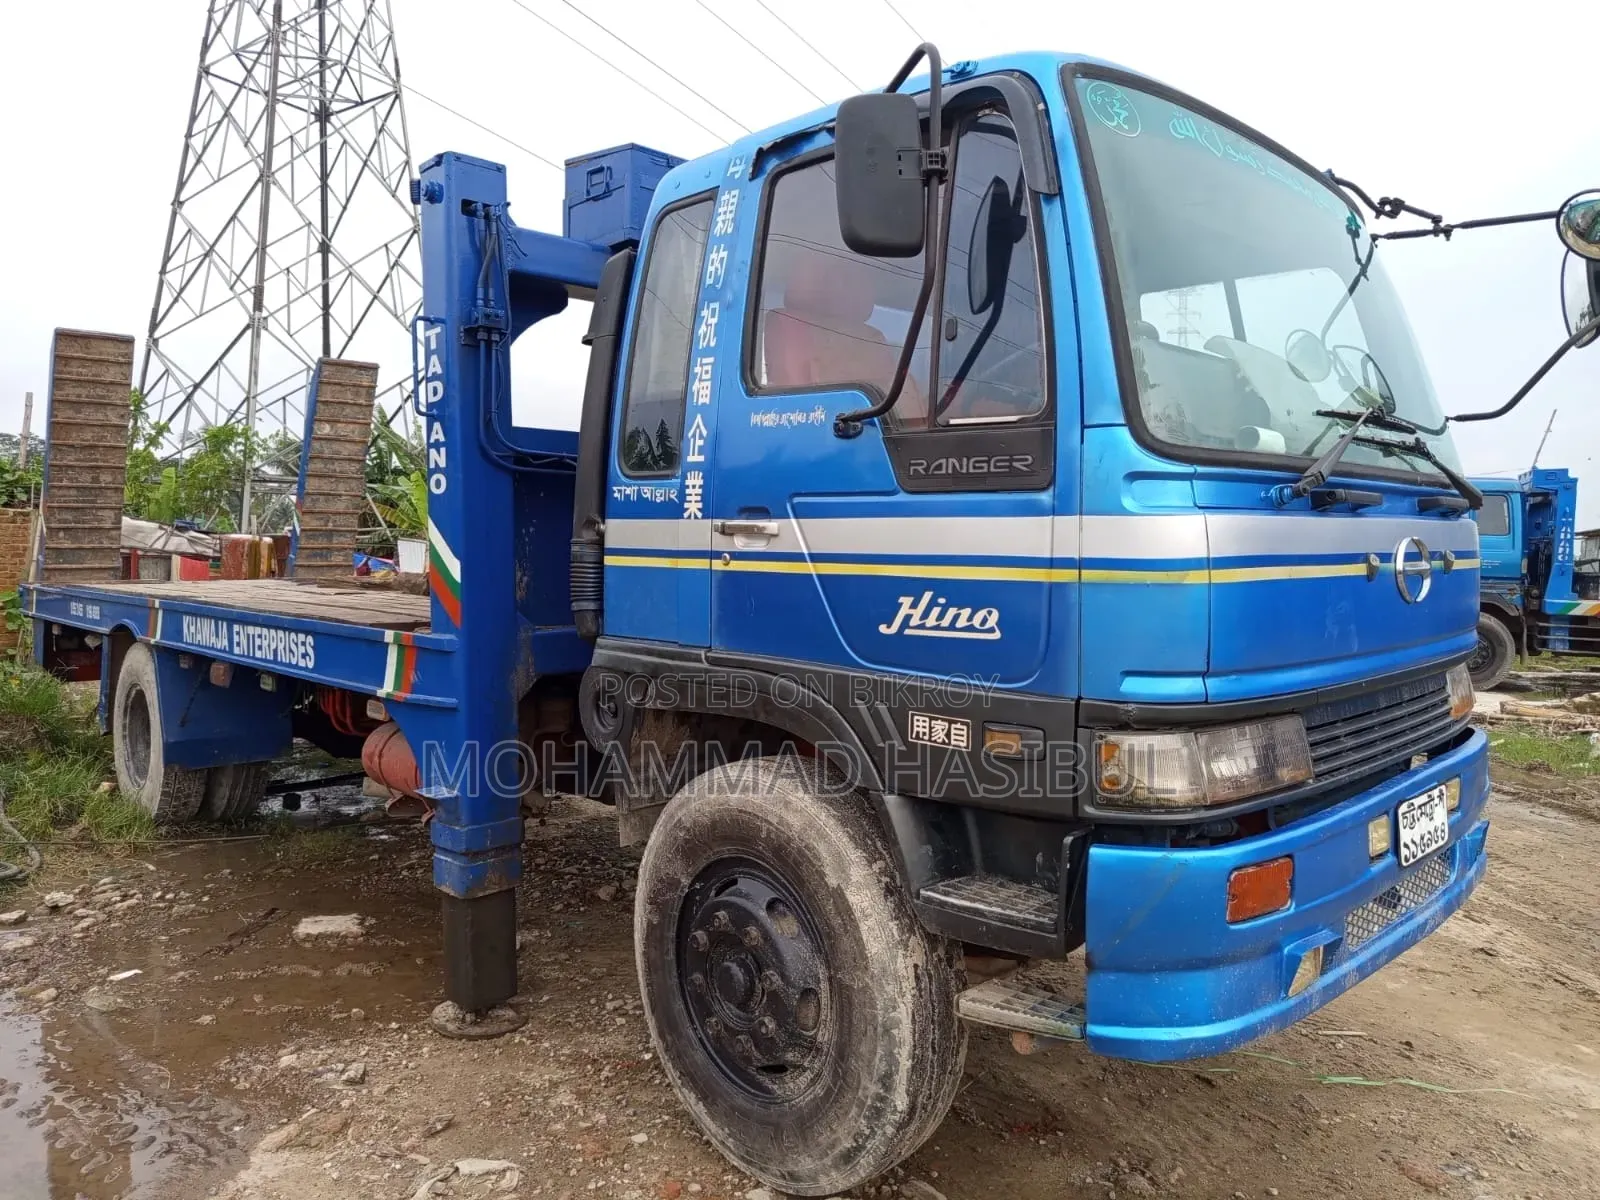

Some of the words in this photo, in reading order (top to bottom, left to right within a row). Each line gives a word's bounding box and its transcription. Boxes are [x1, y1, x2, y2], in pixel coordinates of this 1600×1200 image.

[425, 326, 447, 495] TADANO
[909, 454, 1034, 476] RANGER
[878, 591, 1001, 640] Hino
[182, 615, 229, 652] KHAWAJA
[232, 624, 315, 669] ENTERPRISES
